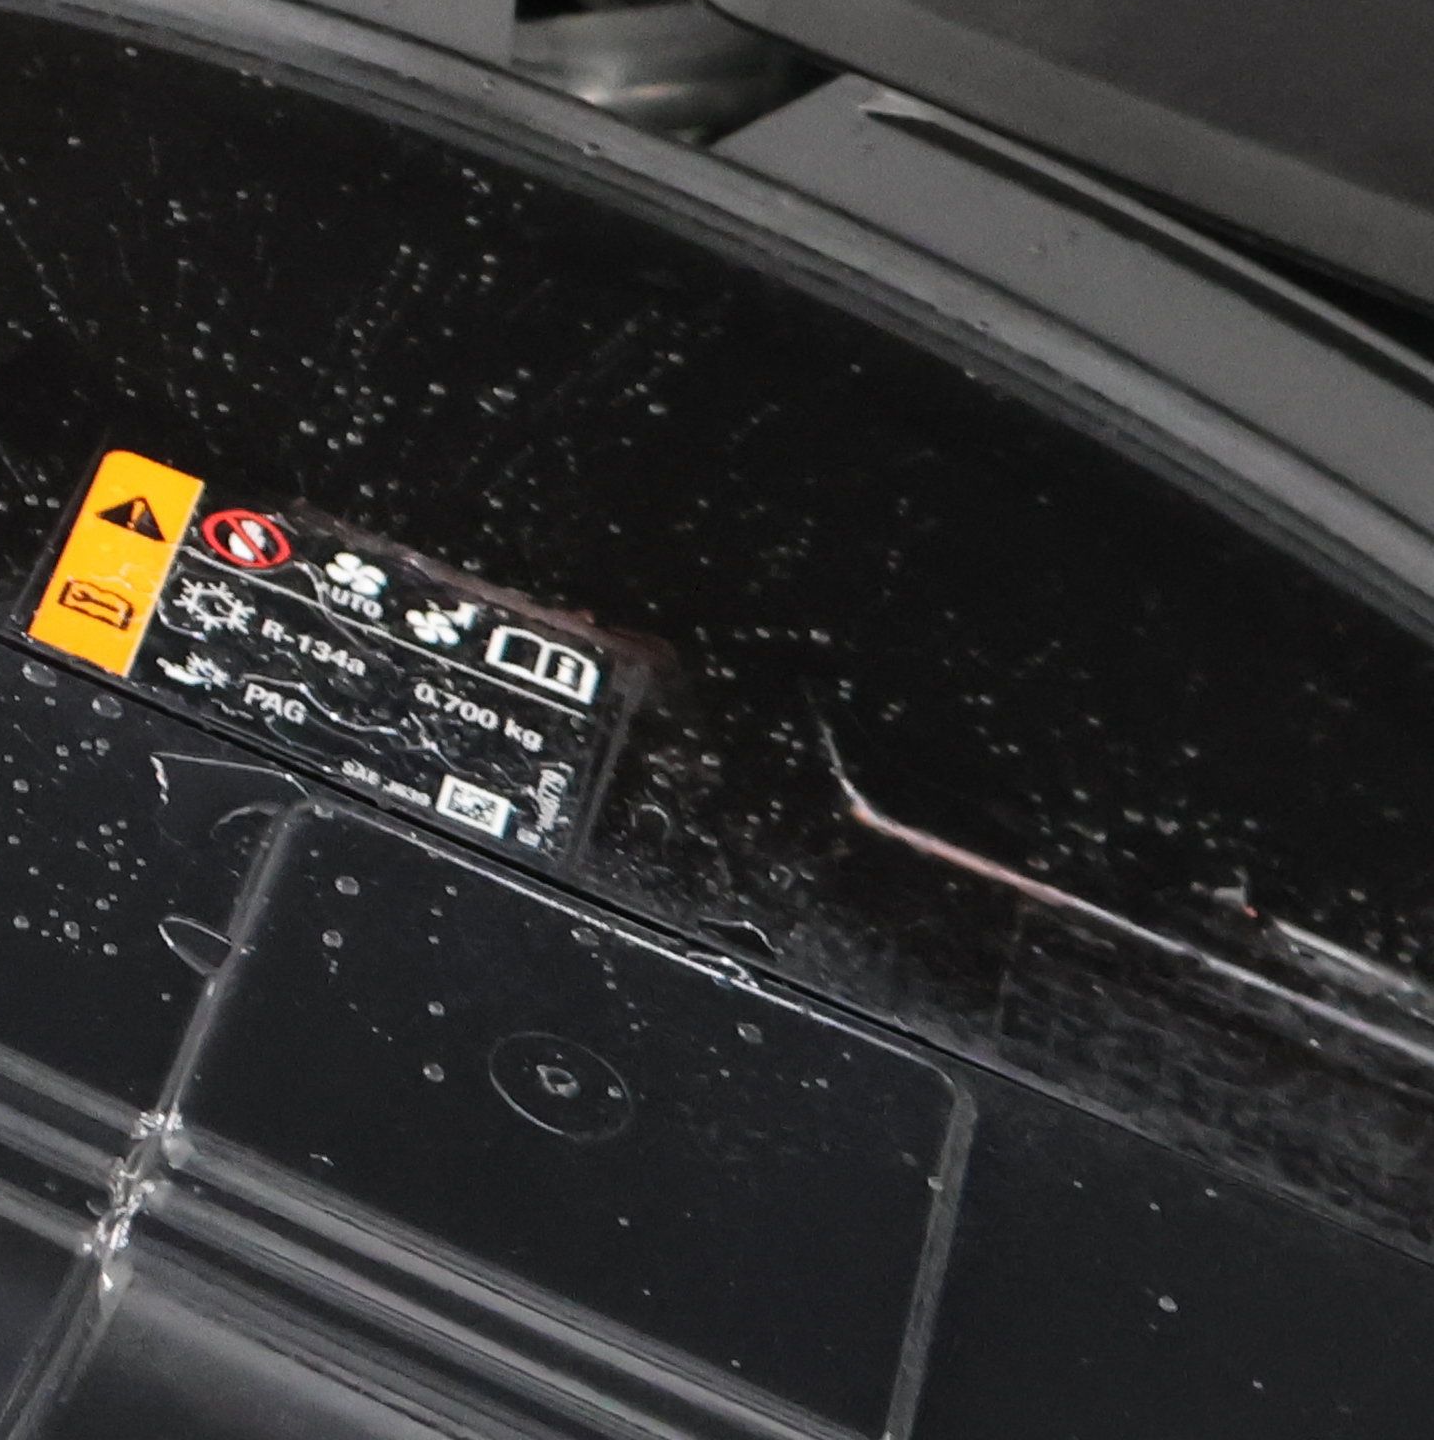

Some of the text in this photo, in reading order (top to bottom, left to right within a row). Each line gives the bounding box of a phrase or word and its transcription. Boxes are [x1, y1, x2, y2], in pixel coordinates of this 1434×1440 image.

[262, 619, 366, 676] R-134a
[244, 682, 307, 725] PAG
[414, 682, 544, 753] 0.700 kg
